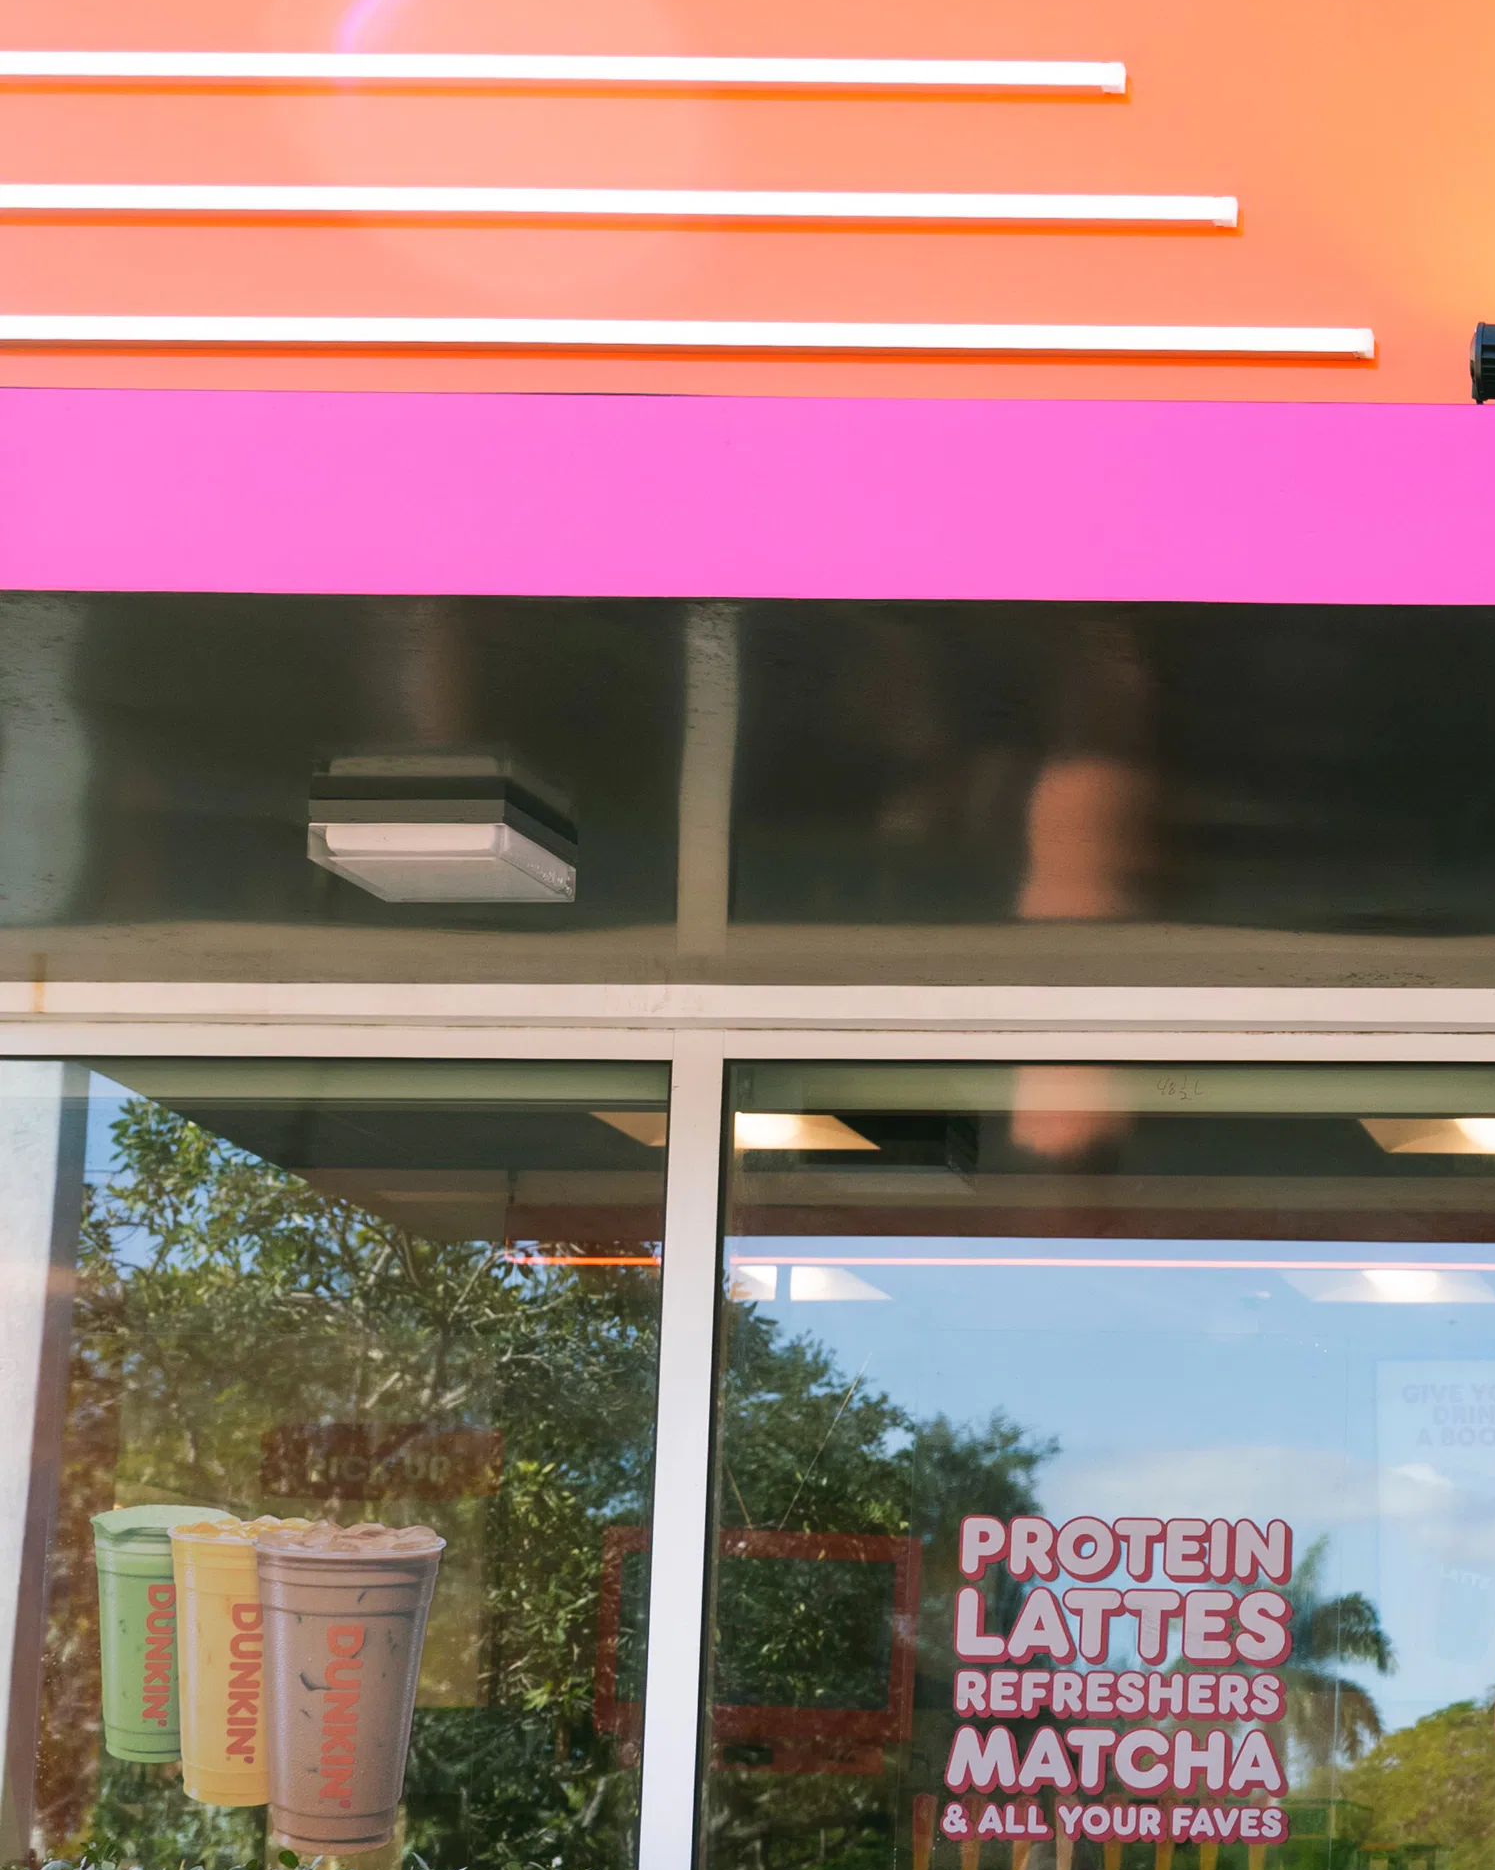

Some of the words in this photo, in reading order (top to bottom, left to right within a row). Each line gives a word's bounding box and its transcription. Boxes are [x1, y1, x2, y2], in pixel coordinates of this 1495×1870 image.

[959, 1515, 1293, 1585] PROTEIN
[142, 1584, 177, 1727] DUNKIN'
[954, 1586, 1293, 1667] LATTES
[226, 1603, 264, 1765] DUNKIN'
[319, 1625, 365, 1808] DUNKIN'
[954, 1669, 1287, 1721] REFRESHERS
[944, 1725, 1289, 1797] MATCHA
[941, 1802, 970, 1841] &
[976, 1803, 1051, 1841] ALL
[1056, 1805, 1163, 1843] YOUR
[1170, 1806, 1289, 1844] FAVES
